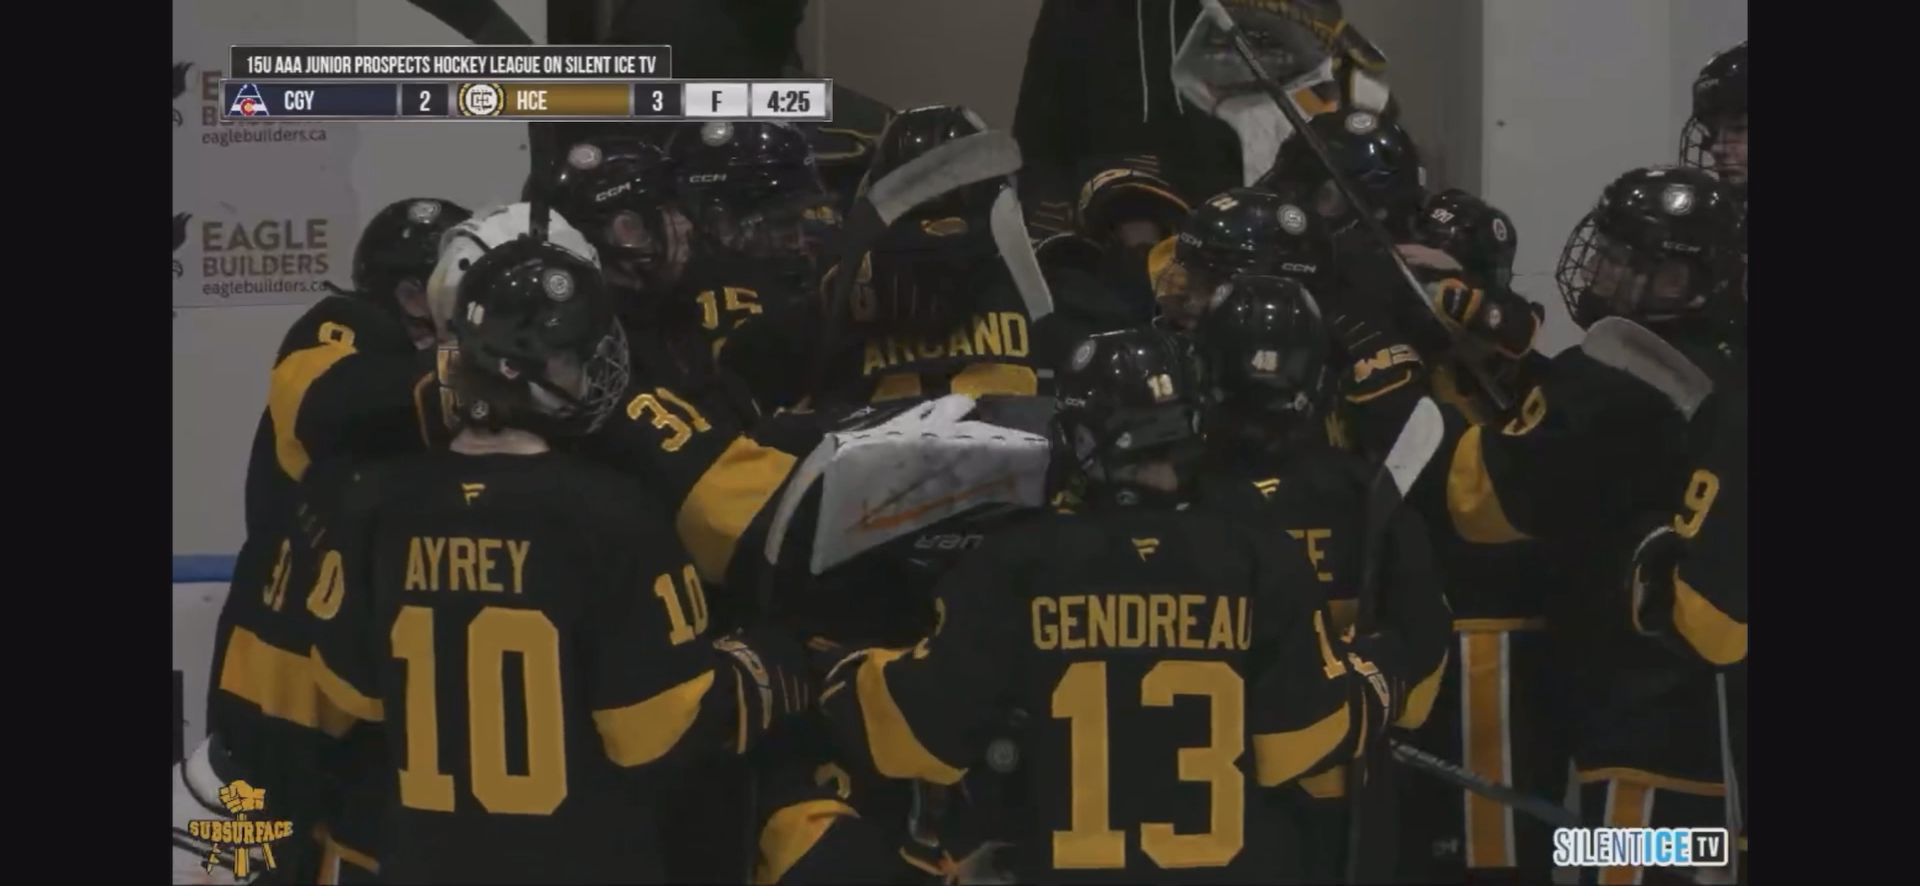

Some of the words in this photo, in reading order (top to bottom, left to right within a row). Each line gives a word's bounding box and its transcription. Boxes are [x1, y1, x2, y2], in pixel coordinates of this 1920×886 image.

[201, 127, 327, 147] eaglebuilders.ca
[595, 181, 632, 202] CCM
[689, 173, 728, 184] CCM
[201, 218, 328, 251] EAGLE
[202, 252, 329, 277] BUILDERS
[1281, 262, 1317, 274] CCM
[201, 279, 328, 298] eaglebuilders.ca
[626, 386, 712, 452] 31
[1674, 469, 1720, 540] 9
[404, 536, 531, 594] AYREY
[653, 564, 708, 645] 10
[1030, 594, 1253, 651] GENDREAU
[390, 605, 568, 815] 10
[1051, 660, 1245, 870] 13
